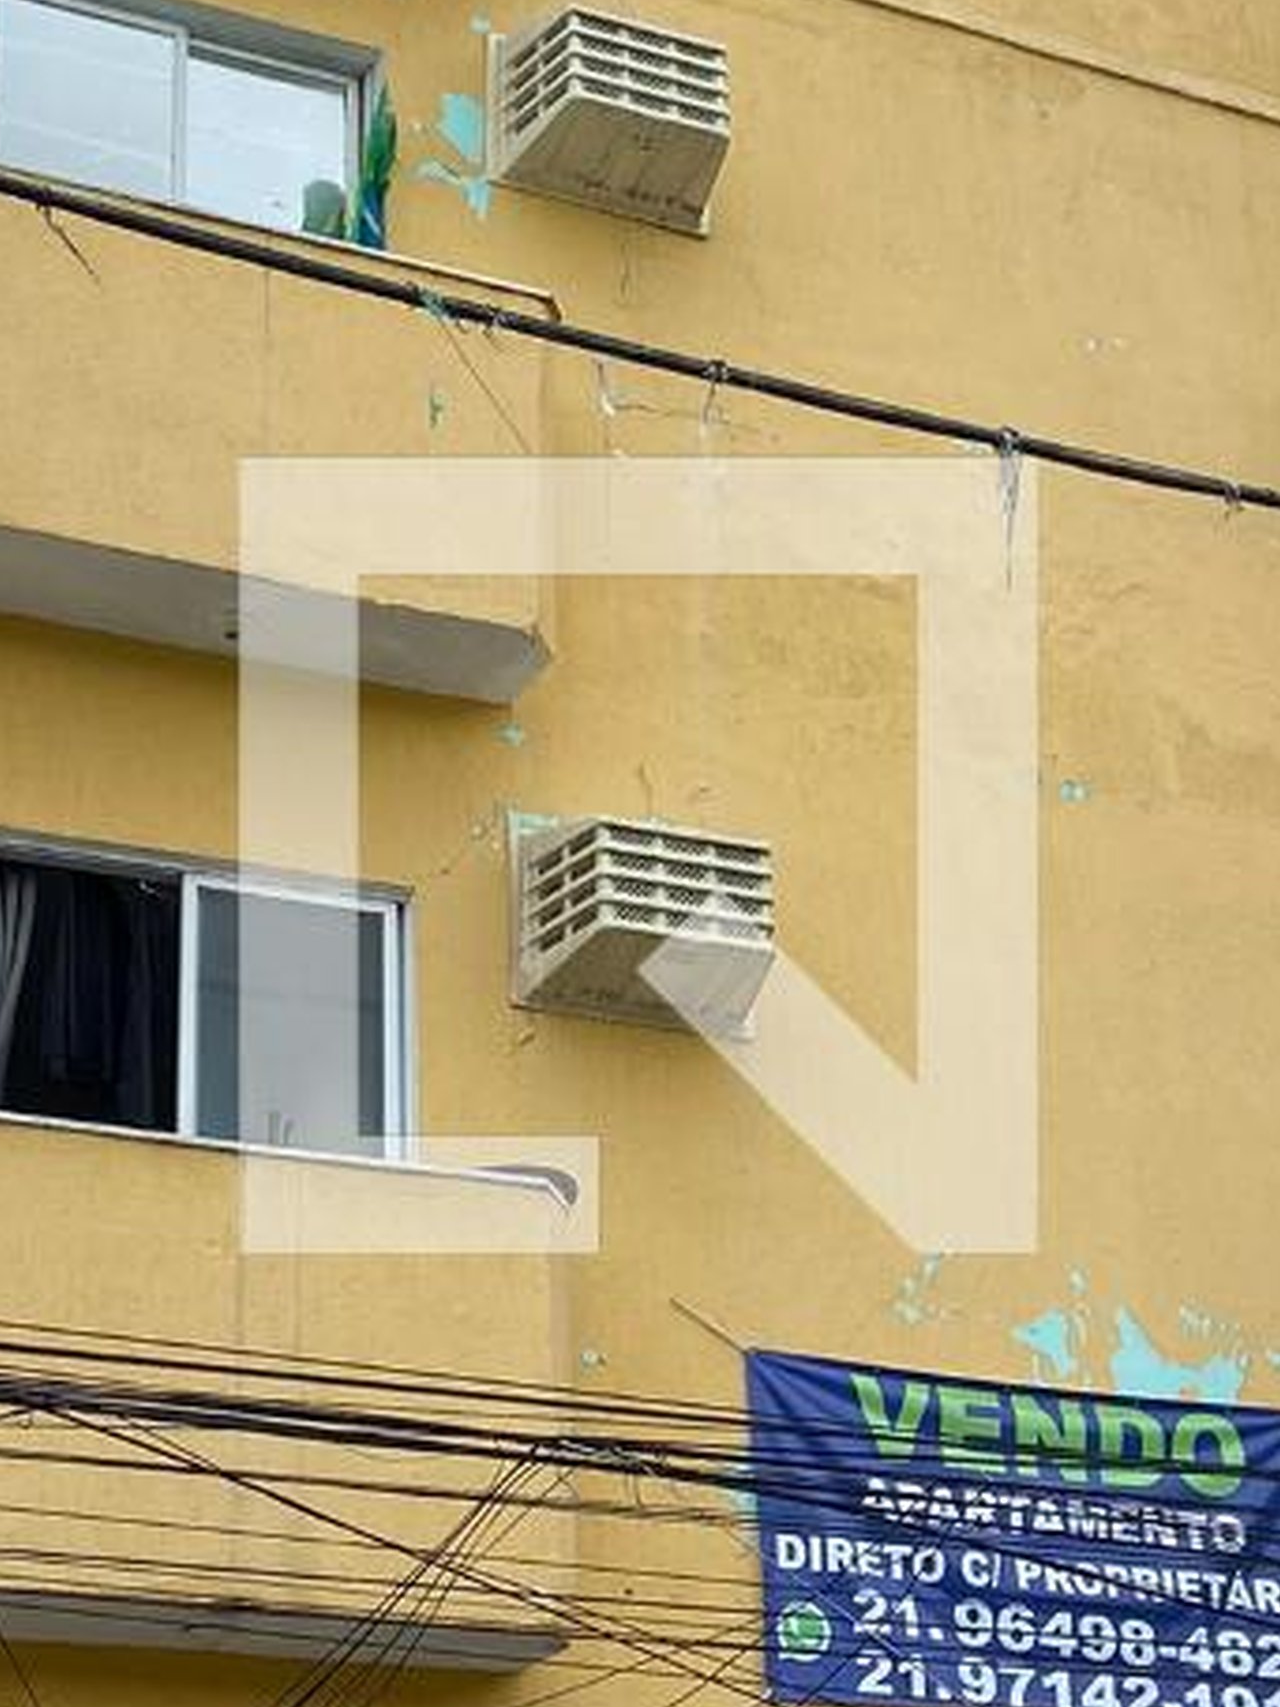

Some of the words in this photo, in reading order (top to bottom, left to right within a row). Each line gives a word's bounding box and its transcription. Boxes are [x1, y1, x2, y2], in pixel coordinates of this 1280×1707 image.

[850, 1373, 1246, 1499] VENDO
[775, 1534, 946, 1585] DIRETO
[961, 1549, 1002, 1588] C/
